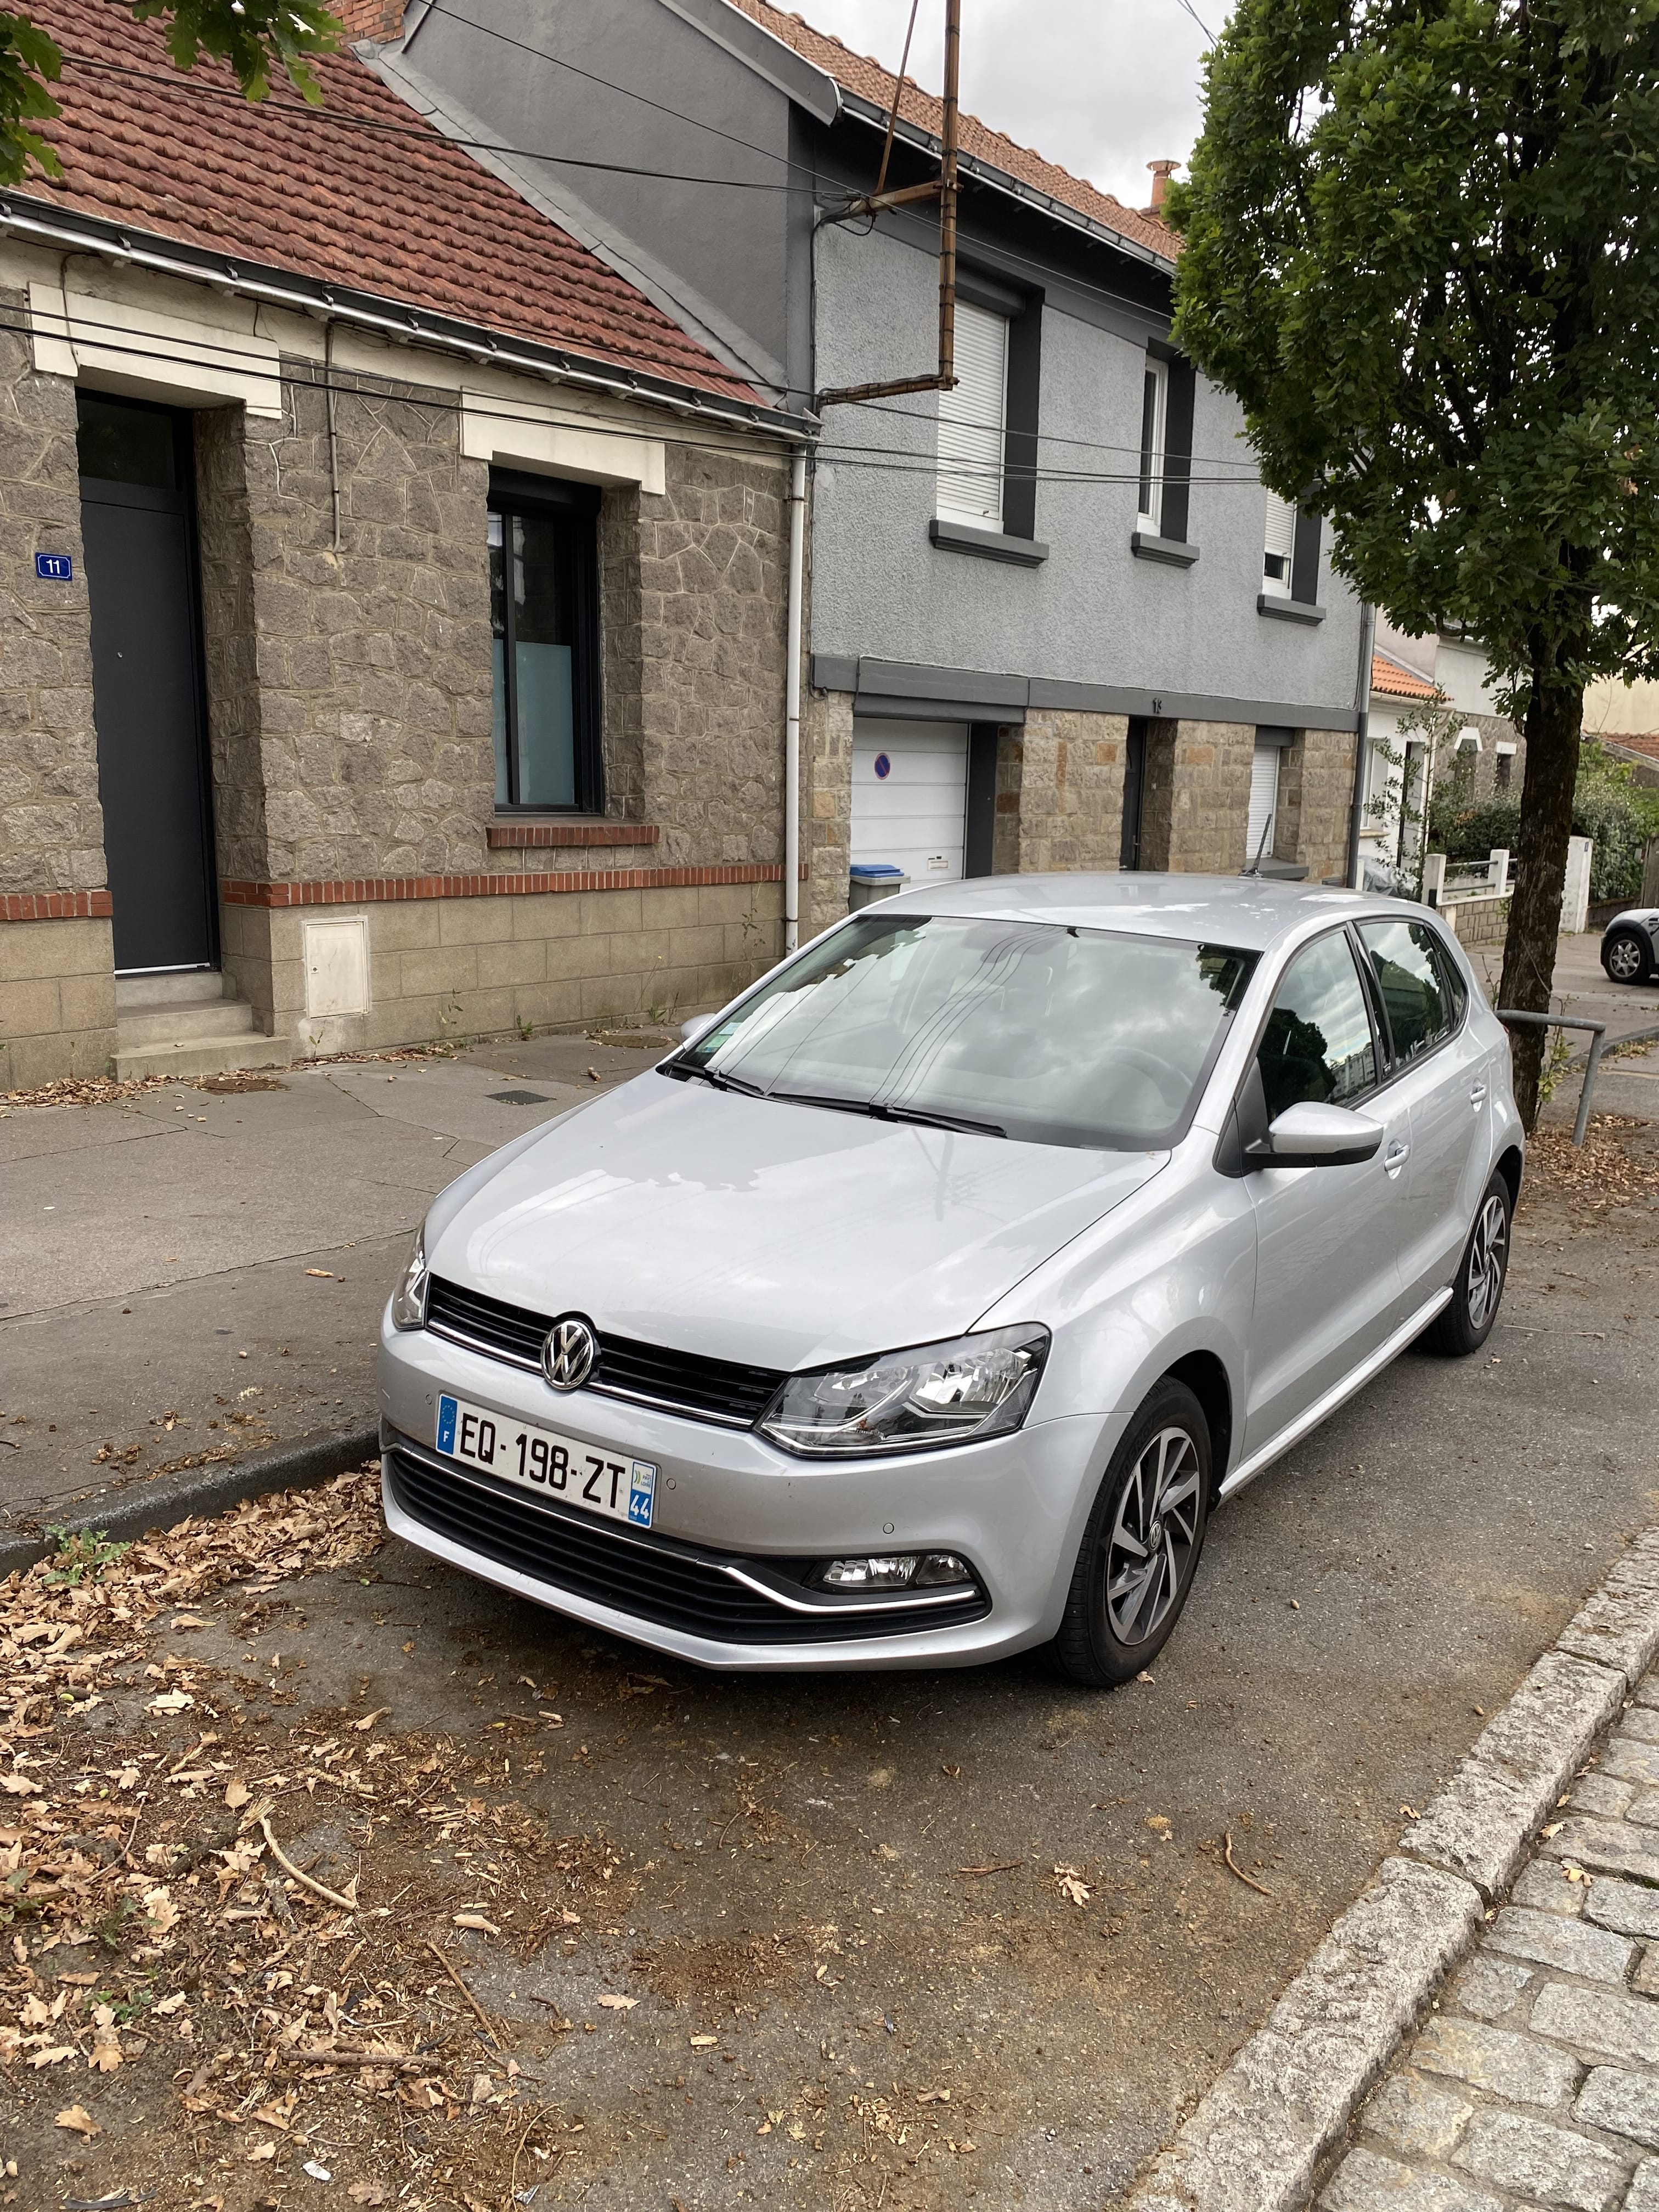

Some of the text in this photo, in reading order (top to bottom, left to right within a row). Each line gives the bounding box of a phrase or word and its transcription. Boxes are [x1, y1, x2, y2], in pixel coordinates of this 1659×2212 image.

[46, 559, 60, 574] 11
[443, 1431, 449, 1442] F
[460, 1413, 626, 1509] EQ-198-ZT
[630, 1494, 649, 1520] 44
